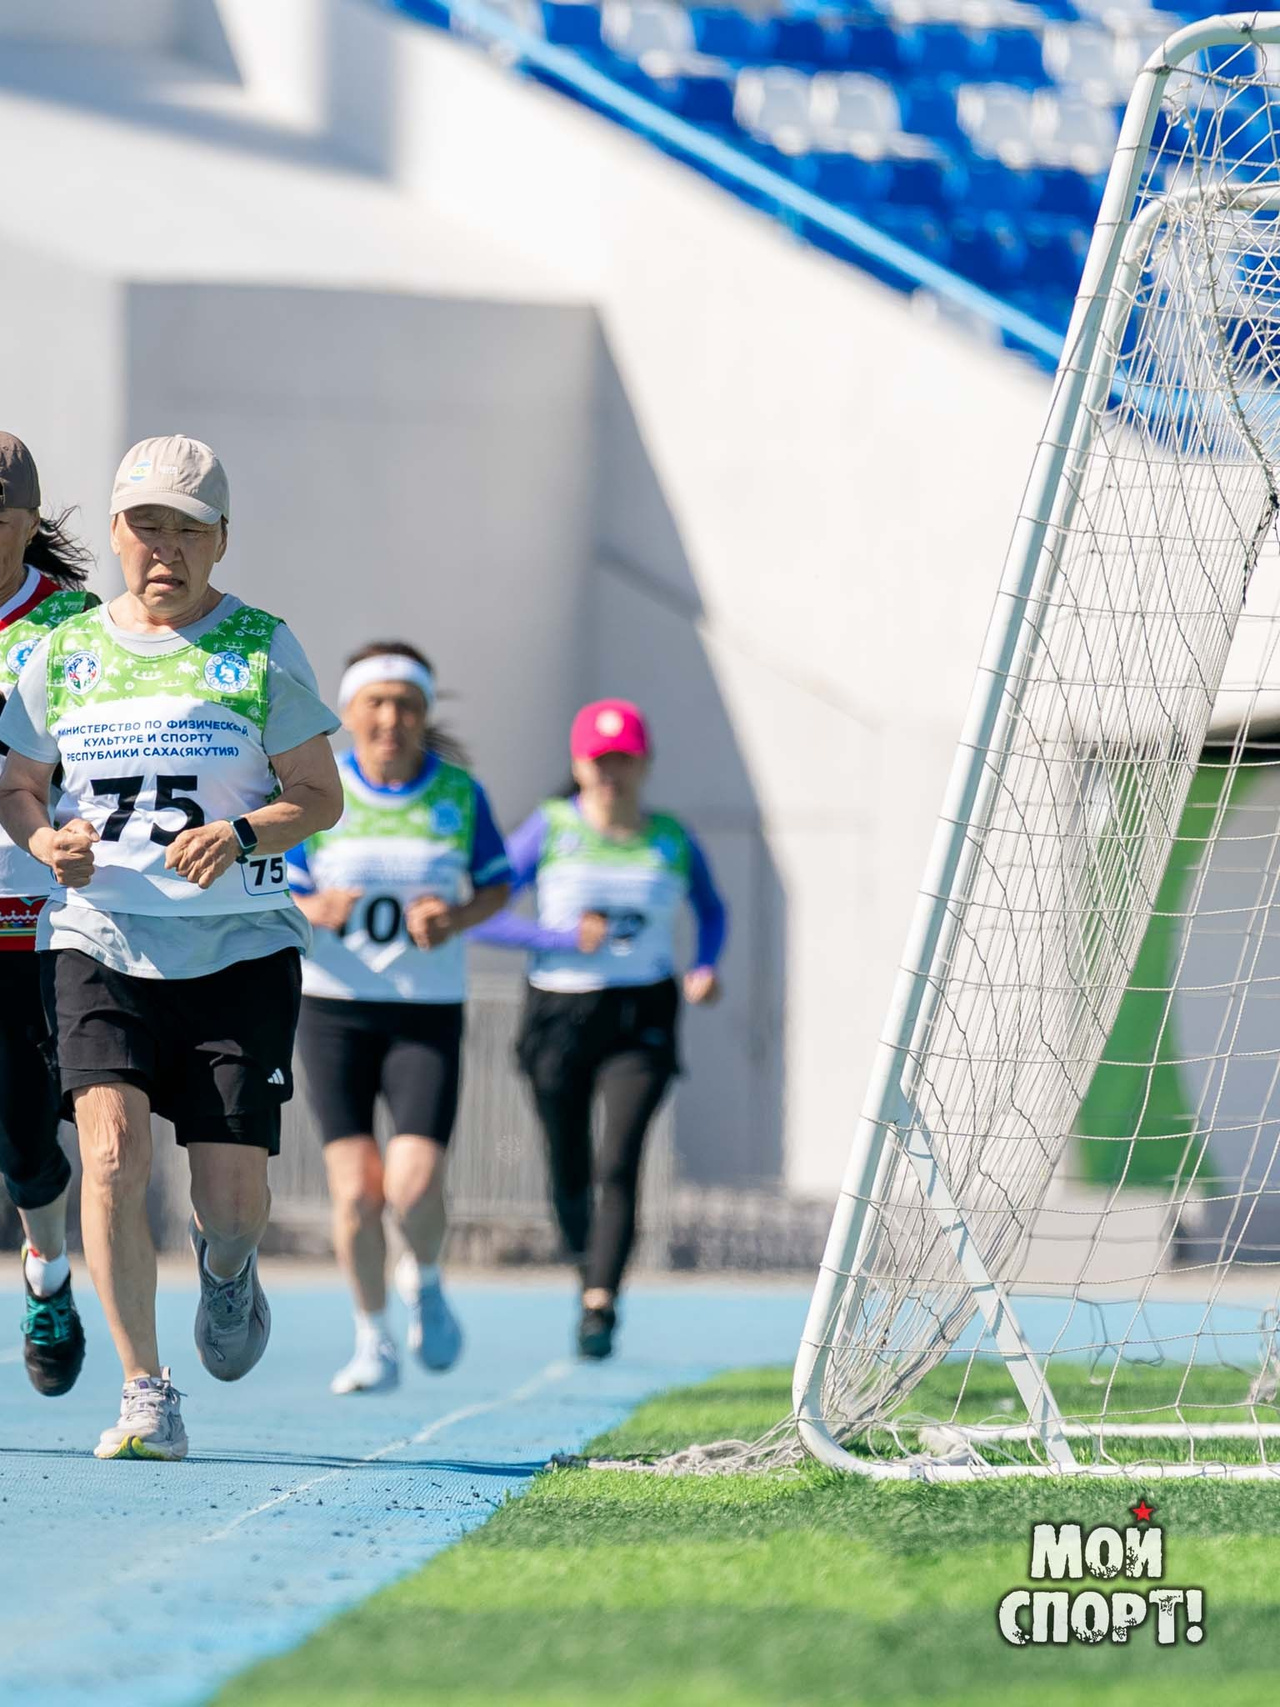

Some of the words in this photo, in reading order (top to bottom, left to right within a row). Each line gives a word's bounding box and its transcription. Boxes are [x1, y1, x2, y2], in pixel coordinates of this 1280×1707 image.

[144, 719, 163, 729] ПО
[83, 733, 144, 748] КУЛЬТУРЕ
[147, 733, 157, 743] И
[160, 733, 213, 744] СПОРТУ
[142, 746, 240, 758] САХА(ЯКУТИЯ)
[90, 775, 205, 847] 75
[249, 856, 284, 887] 75
